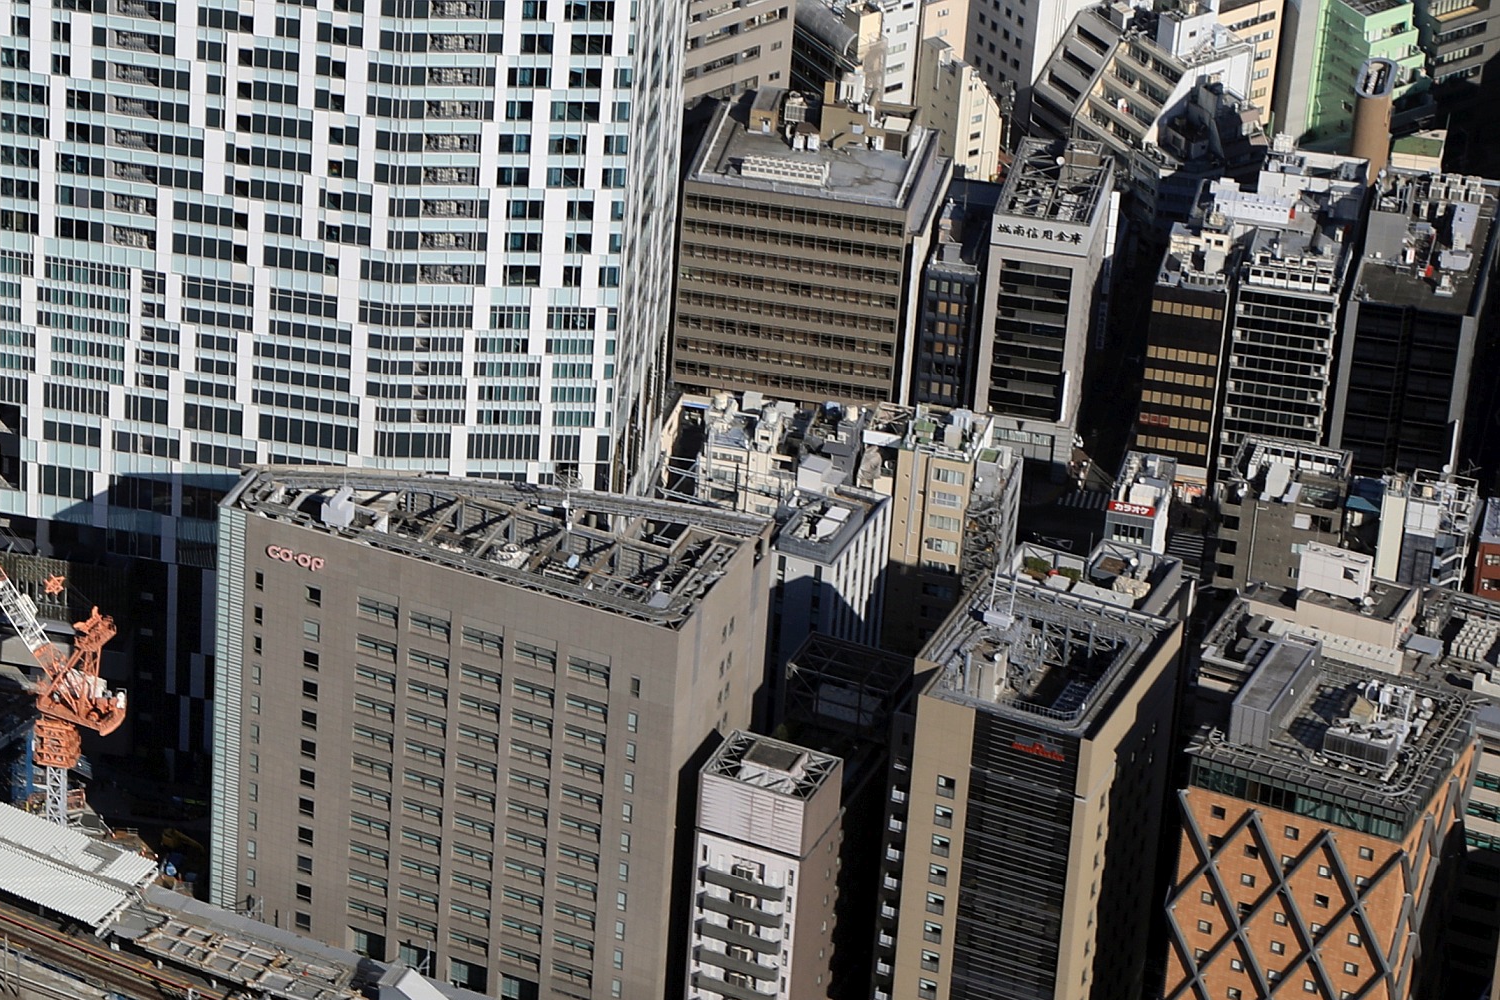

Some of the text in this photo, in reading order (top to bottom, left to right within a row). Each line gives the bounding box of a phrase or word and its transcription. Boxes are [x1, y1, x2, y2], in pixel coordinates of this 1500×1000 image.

[997, 223, 1083, 245] 城南信用金庫
[1114, 503, 1150, 515] カラオケ
